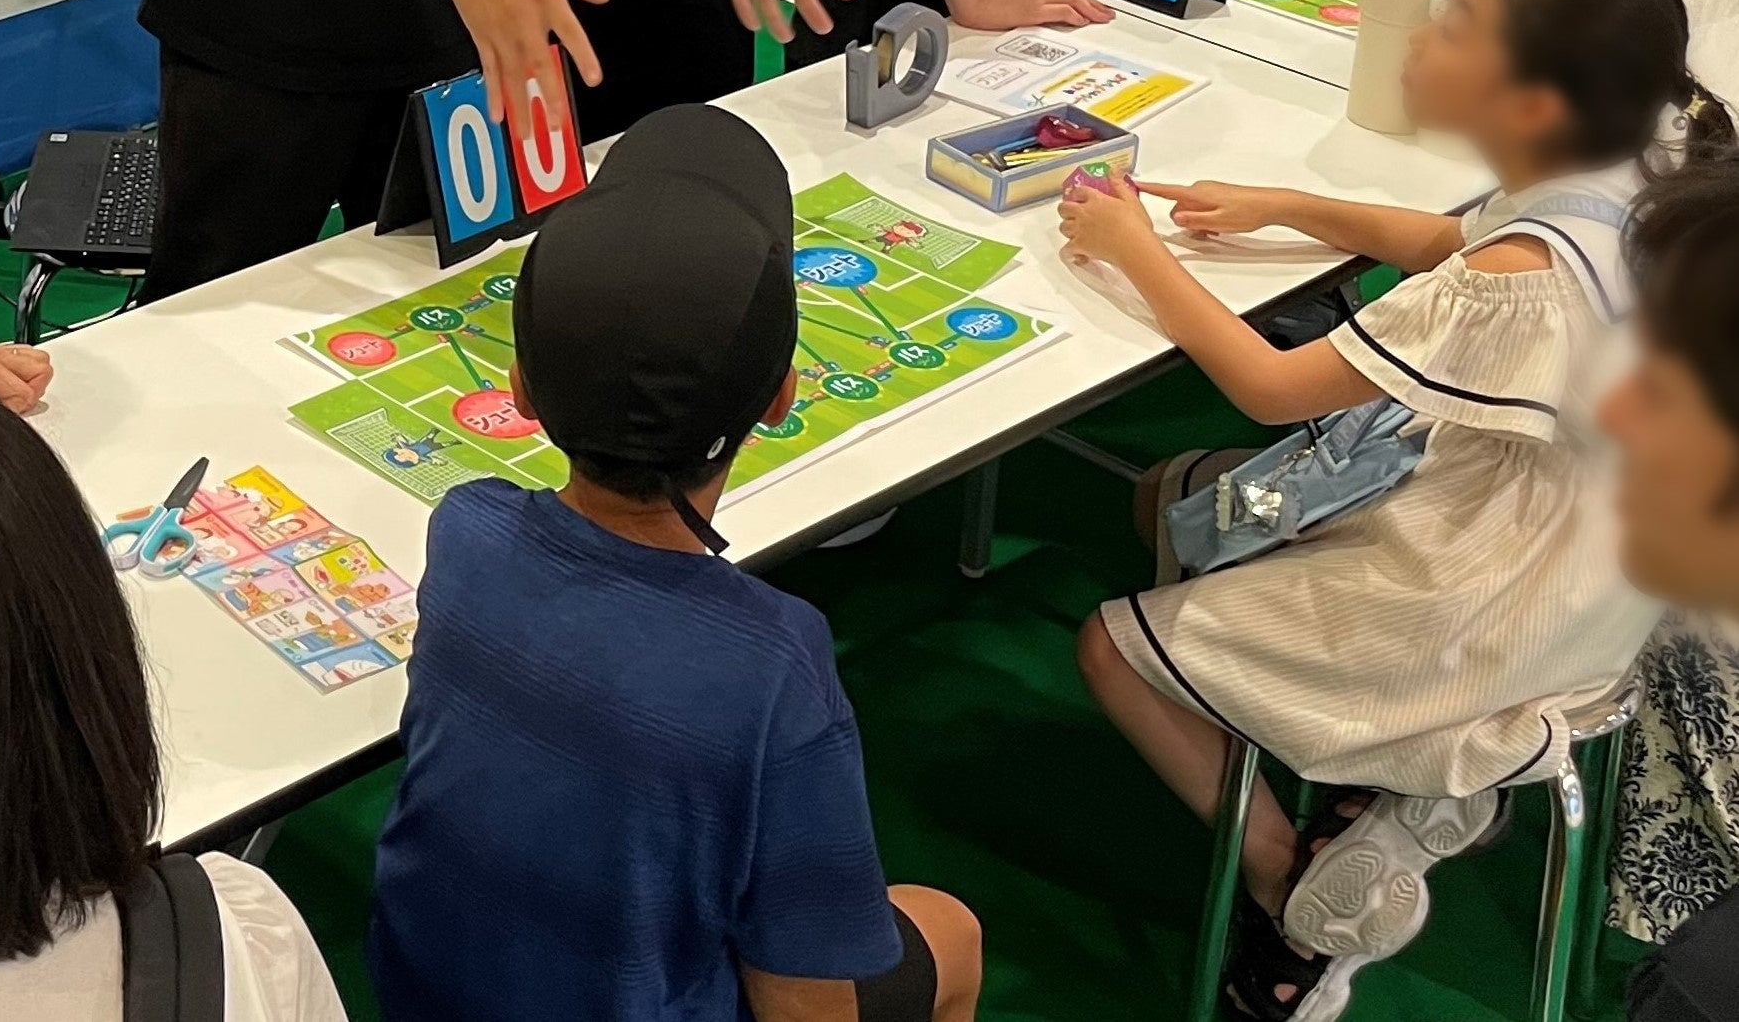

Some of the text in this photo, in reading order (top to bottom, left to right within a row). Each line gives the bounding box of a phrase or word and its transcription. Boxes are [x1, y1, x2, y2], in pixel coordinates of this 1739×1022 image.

[448, 104, 498, 223] 0
[799, 253, 861, 282] シュート
[418, 310, 450, 324] パス
[959, 313, 1003, 336] シュート
[342, 340, 382, 359] シュート
